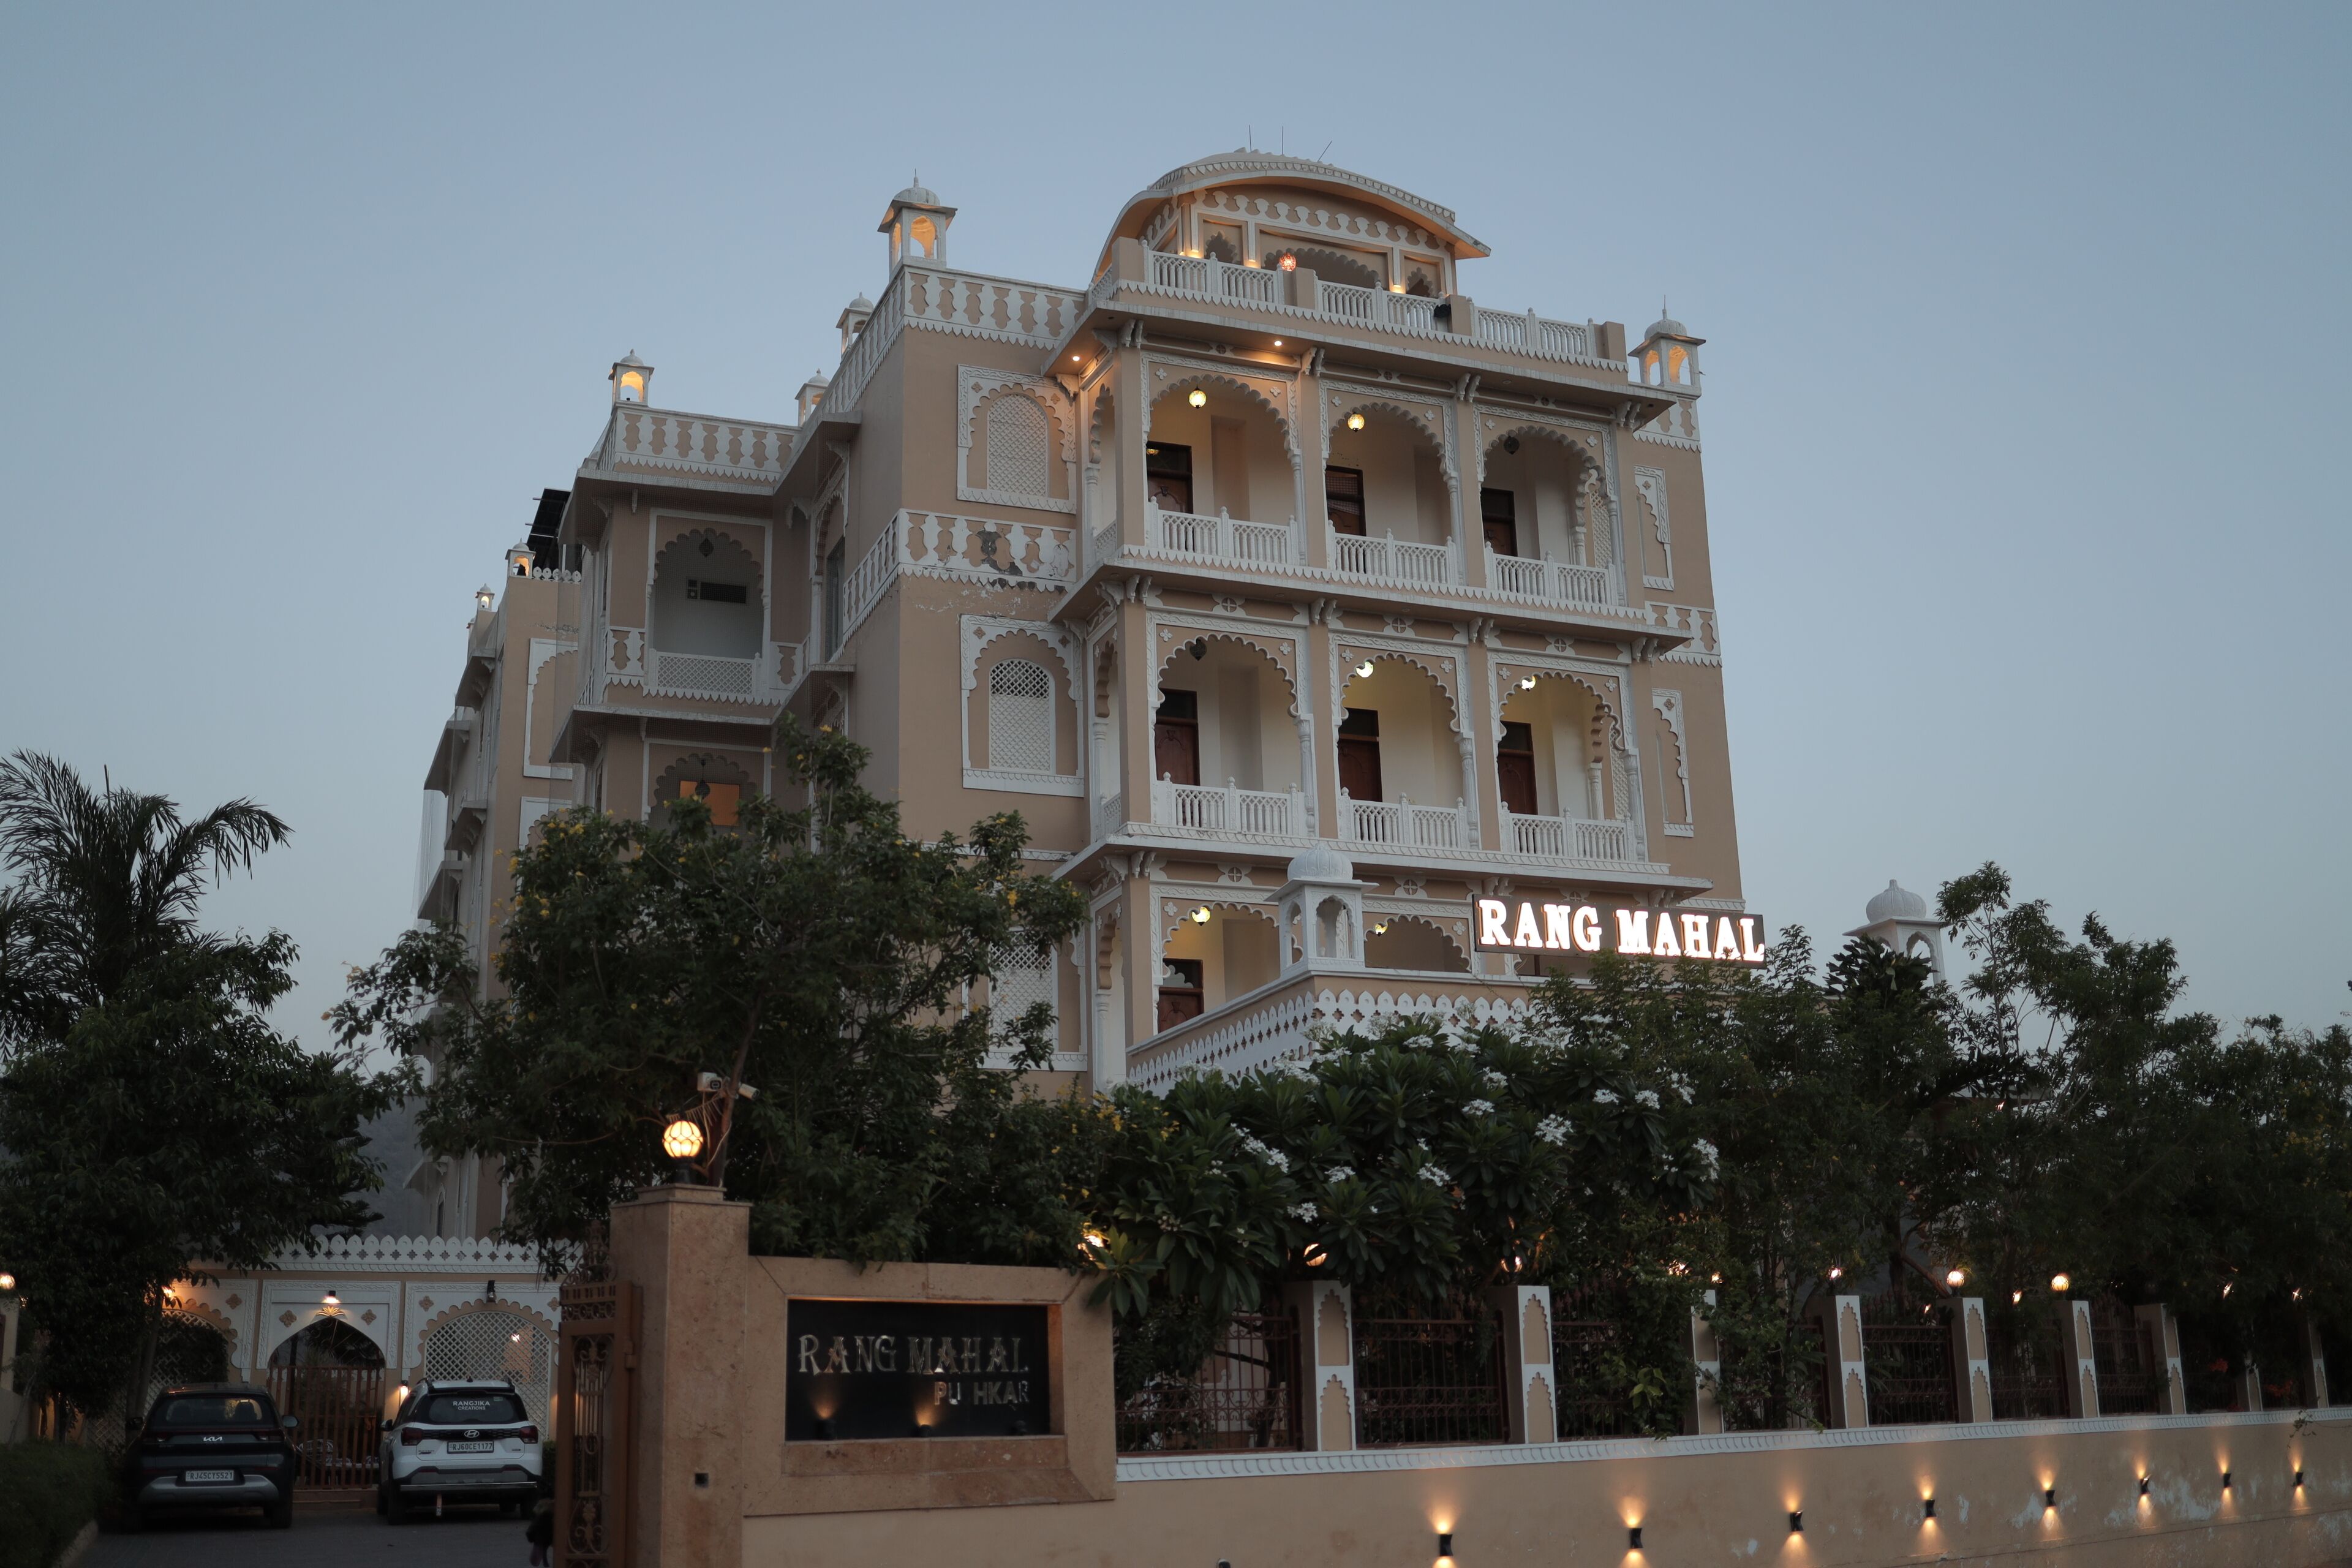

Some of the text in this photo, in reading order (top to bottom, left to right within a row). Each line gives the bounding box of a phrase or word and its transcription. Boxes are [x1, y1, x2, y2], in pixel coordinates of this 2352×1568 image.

[1476, 899, 1765, 962] RANG MAHAL
[798, 1333, 1030, 1376] RANG MAHAL
[452, 1442, 493, 1451] RJ60CE1177
[190, 1471, 233, 1480] RJ45CY5521
